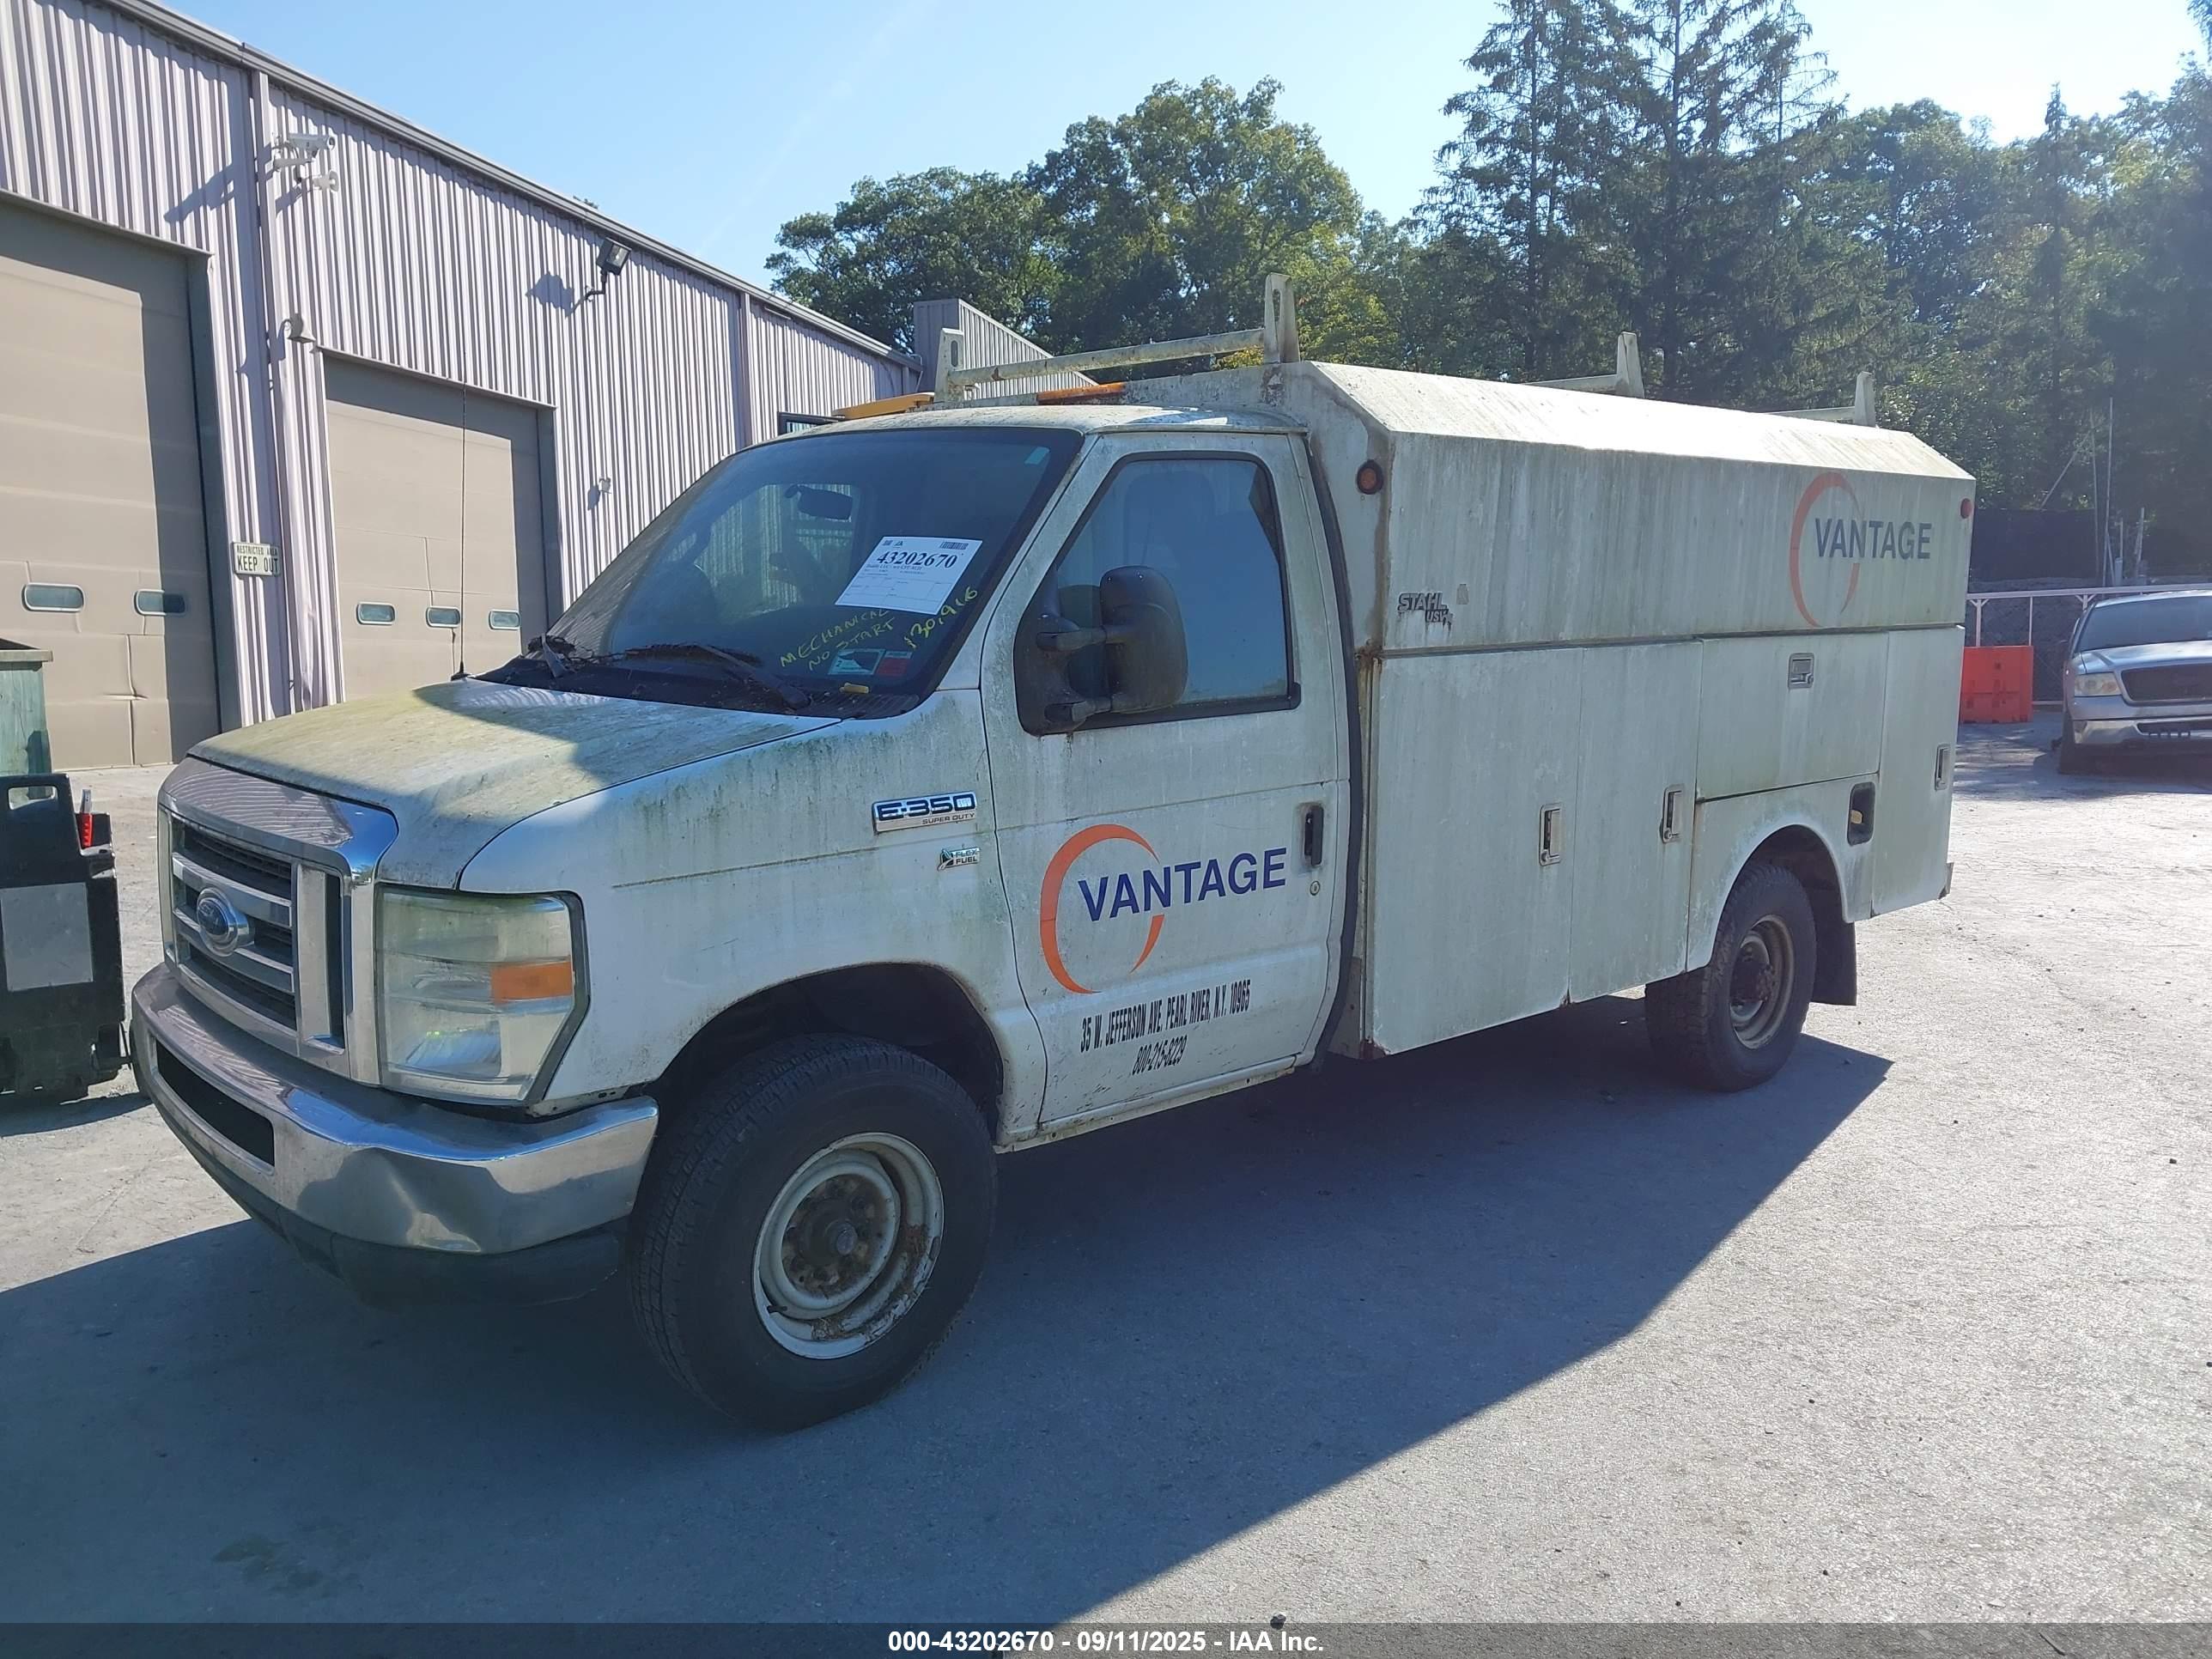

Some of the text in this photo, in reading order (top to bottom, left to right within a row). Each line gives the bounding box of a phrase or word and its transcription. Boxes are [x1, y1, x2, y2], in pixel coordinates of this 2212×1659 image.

[1815, 518, 1931, 559] VANTAGE
[237, 545, 264, 555] RESTRICTED
[877, 550, 958, 568] 43202670
[237, 556, 278, 572] KEEP OUT
[1397, 592, 1448, 611] STAHL
[809, 651, 830, 671] NO
[877, 793, 975, 821] E-350
[922, 816, 950, 824] SUPER
[1078, 847, 1287, 921] VANTAGE
[1080, 1017, 1091, 1053] 35
[1094, 1014, 1103, 1049] W.
[1105, 1003, 1147, 1047] JEFFERSON
[1165, 993, 1188, 1030] PEARL
[1189, 988, 1211, 1023] RIVER,
[1213, 984, 1227, 1018] N.Y.
[1230, 979, 1251, 1015] 10965
